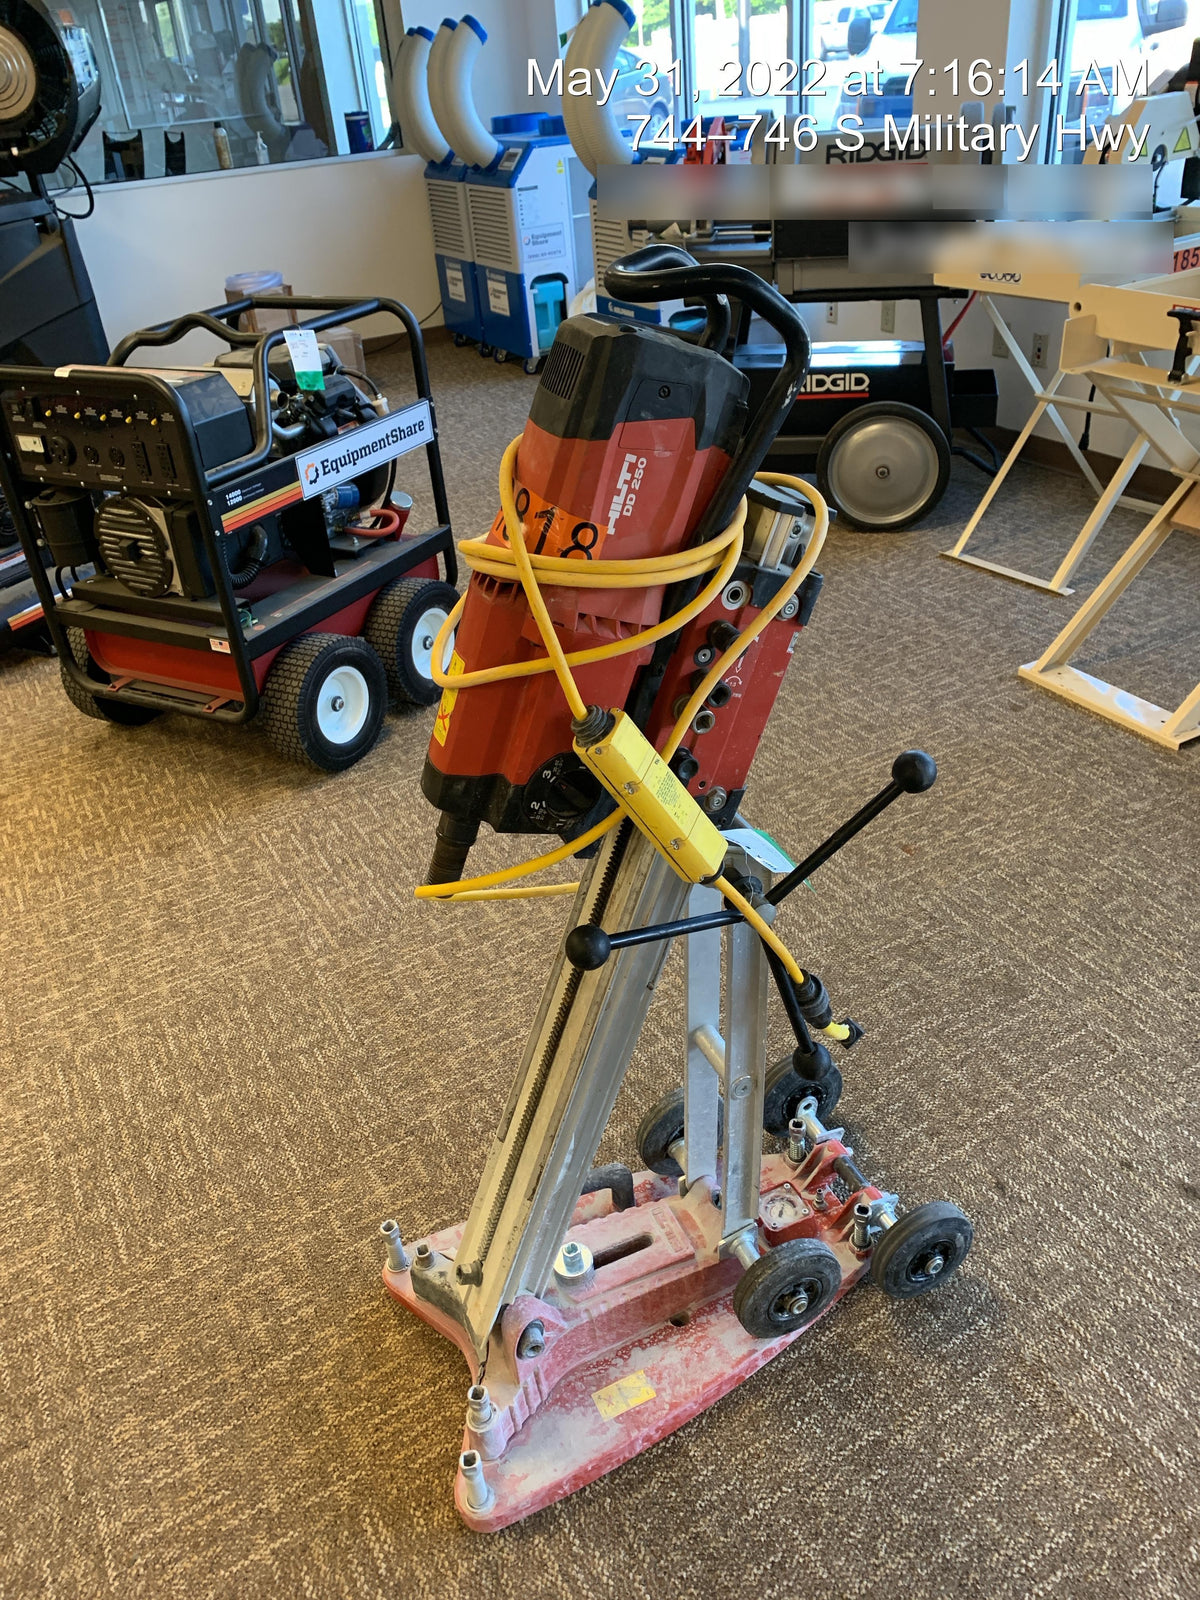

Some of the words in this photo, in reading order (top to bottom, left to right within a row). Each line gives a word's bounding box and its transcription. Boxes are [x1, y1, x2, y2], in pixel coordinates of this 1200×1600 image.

[825, 139, 928, 164] RIDGID
[800, 373, 870, 392] IDGID
[320, 418, 425, 476] EquipmentShare
[607, 453, 637, 535] HILTI
[623, 493, 636, 517] DD
[631, 457, 647, 490] 250
[542, 769, 552, 779] 3
[530, 801, 541, 810] 2
